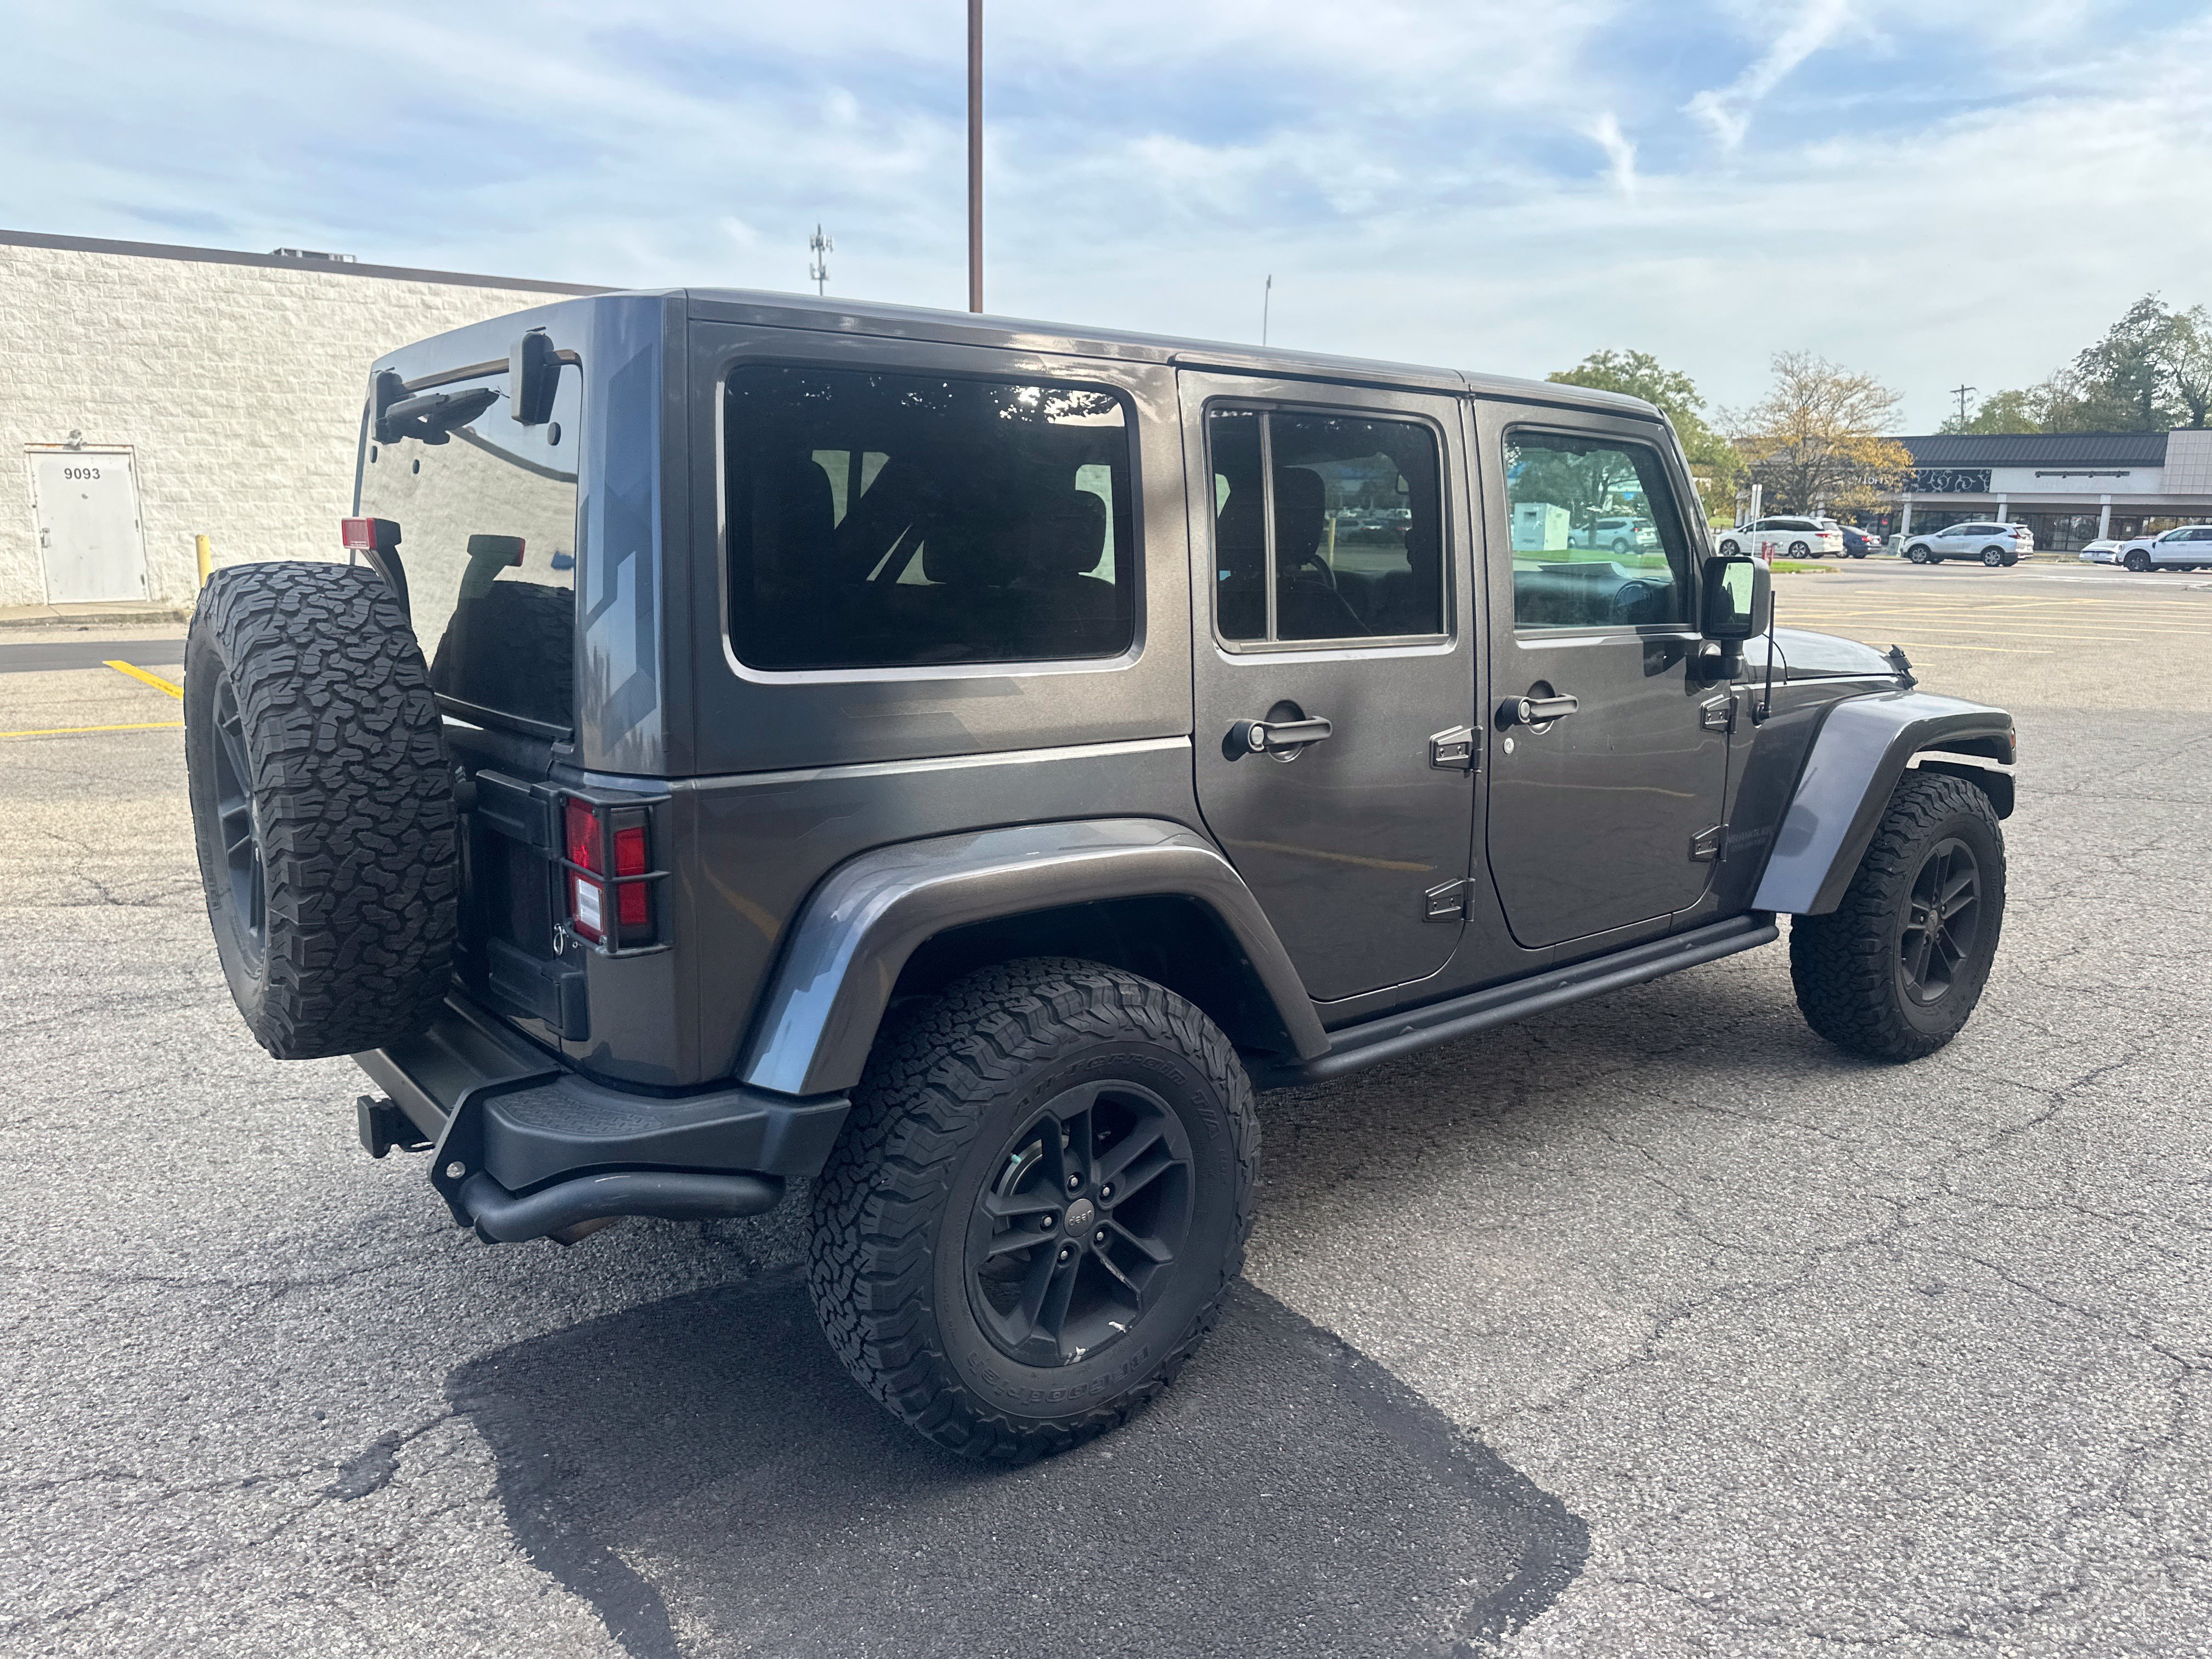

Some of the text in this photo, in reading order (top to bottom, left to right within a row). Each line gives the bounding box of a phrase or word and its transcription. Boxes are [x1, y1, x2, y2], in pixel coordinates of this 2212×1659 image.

[64, 468, 100, 479] 9093
[1190, 1089, 1220, 1141] T/A
[1068, 1210, 1092, 1227] Jeep
[967, 1344, 1150, 1404] BFGoodrich
